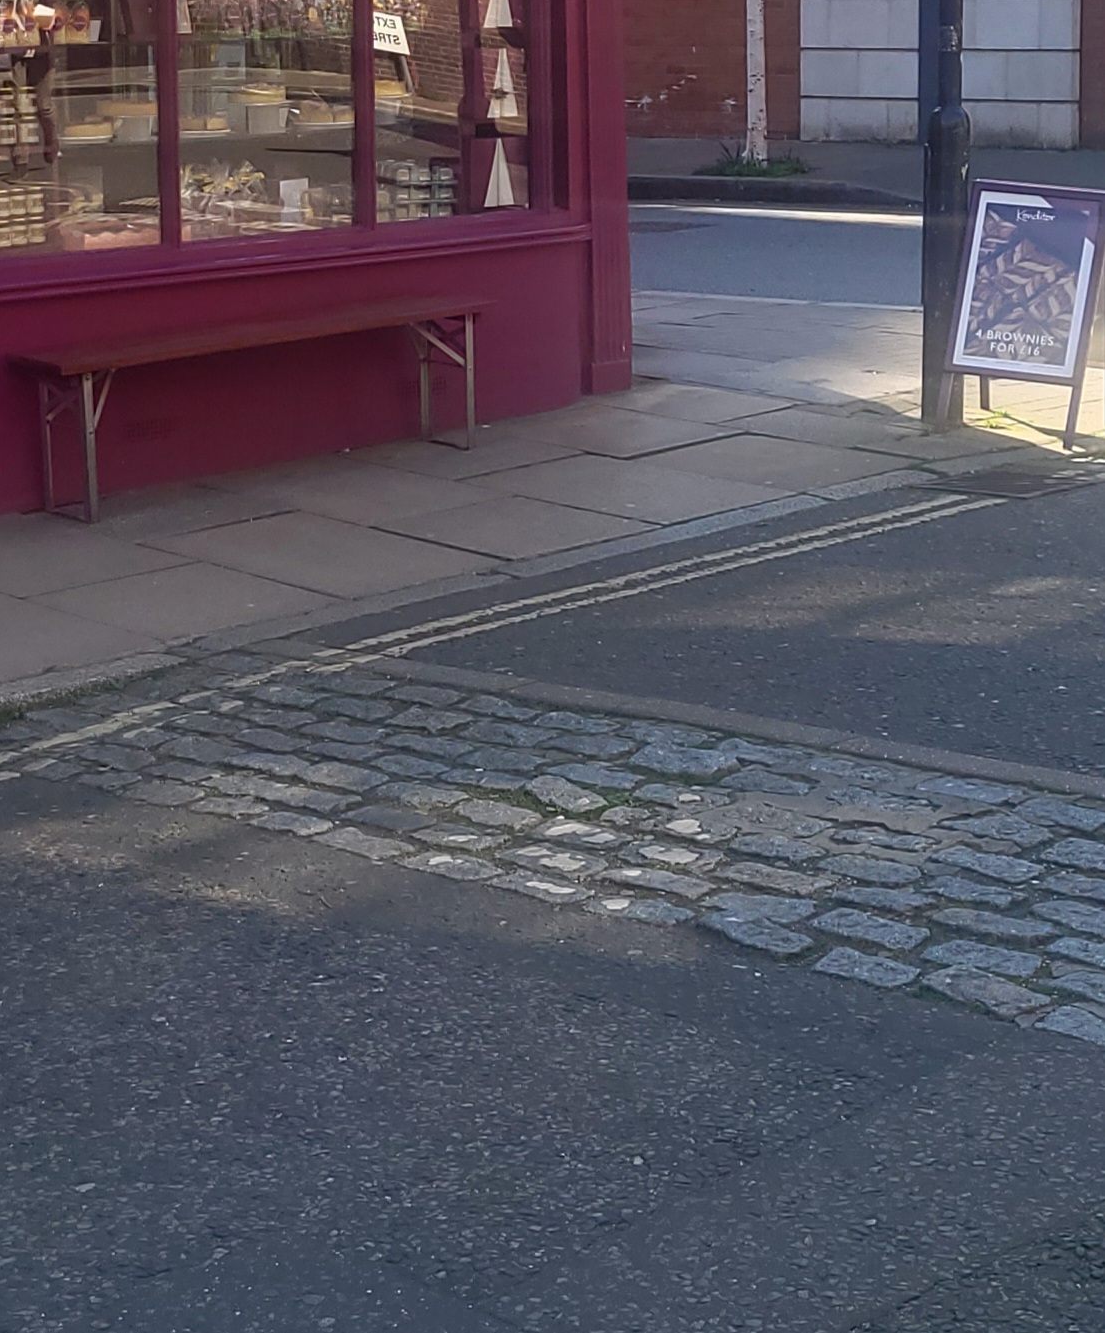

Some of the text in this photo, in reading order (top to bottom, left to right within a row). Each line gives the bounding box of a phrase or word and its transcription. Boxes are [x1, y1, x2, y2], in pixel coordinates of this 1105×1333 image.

[1016, 209, 1056, 222] Konditor
[975, 329, 1055, 346] 4 BROWNIES
[990, 342, 1015, 354] FOR
